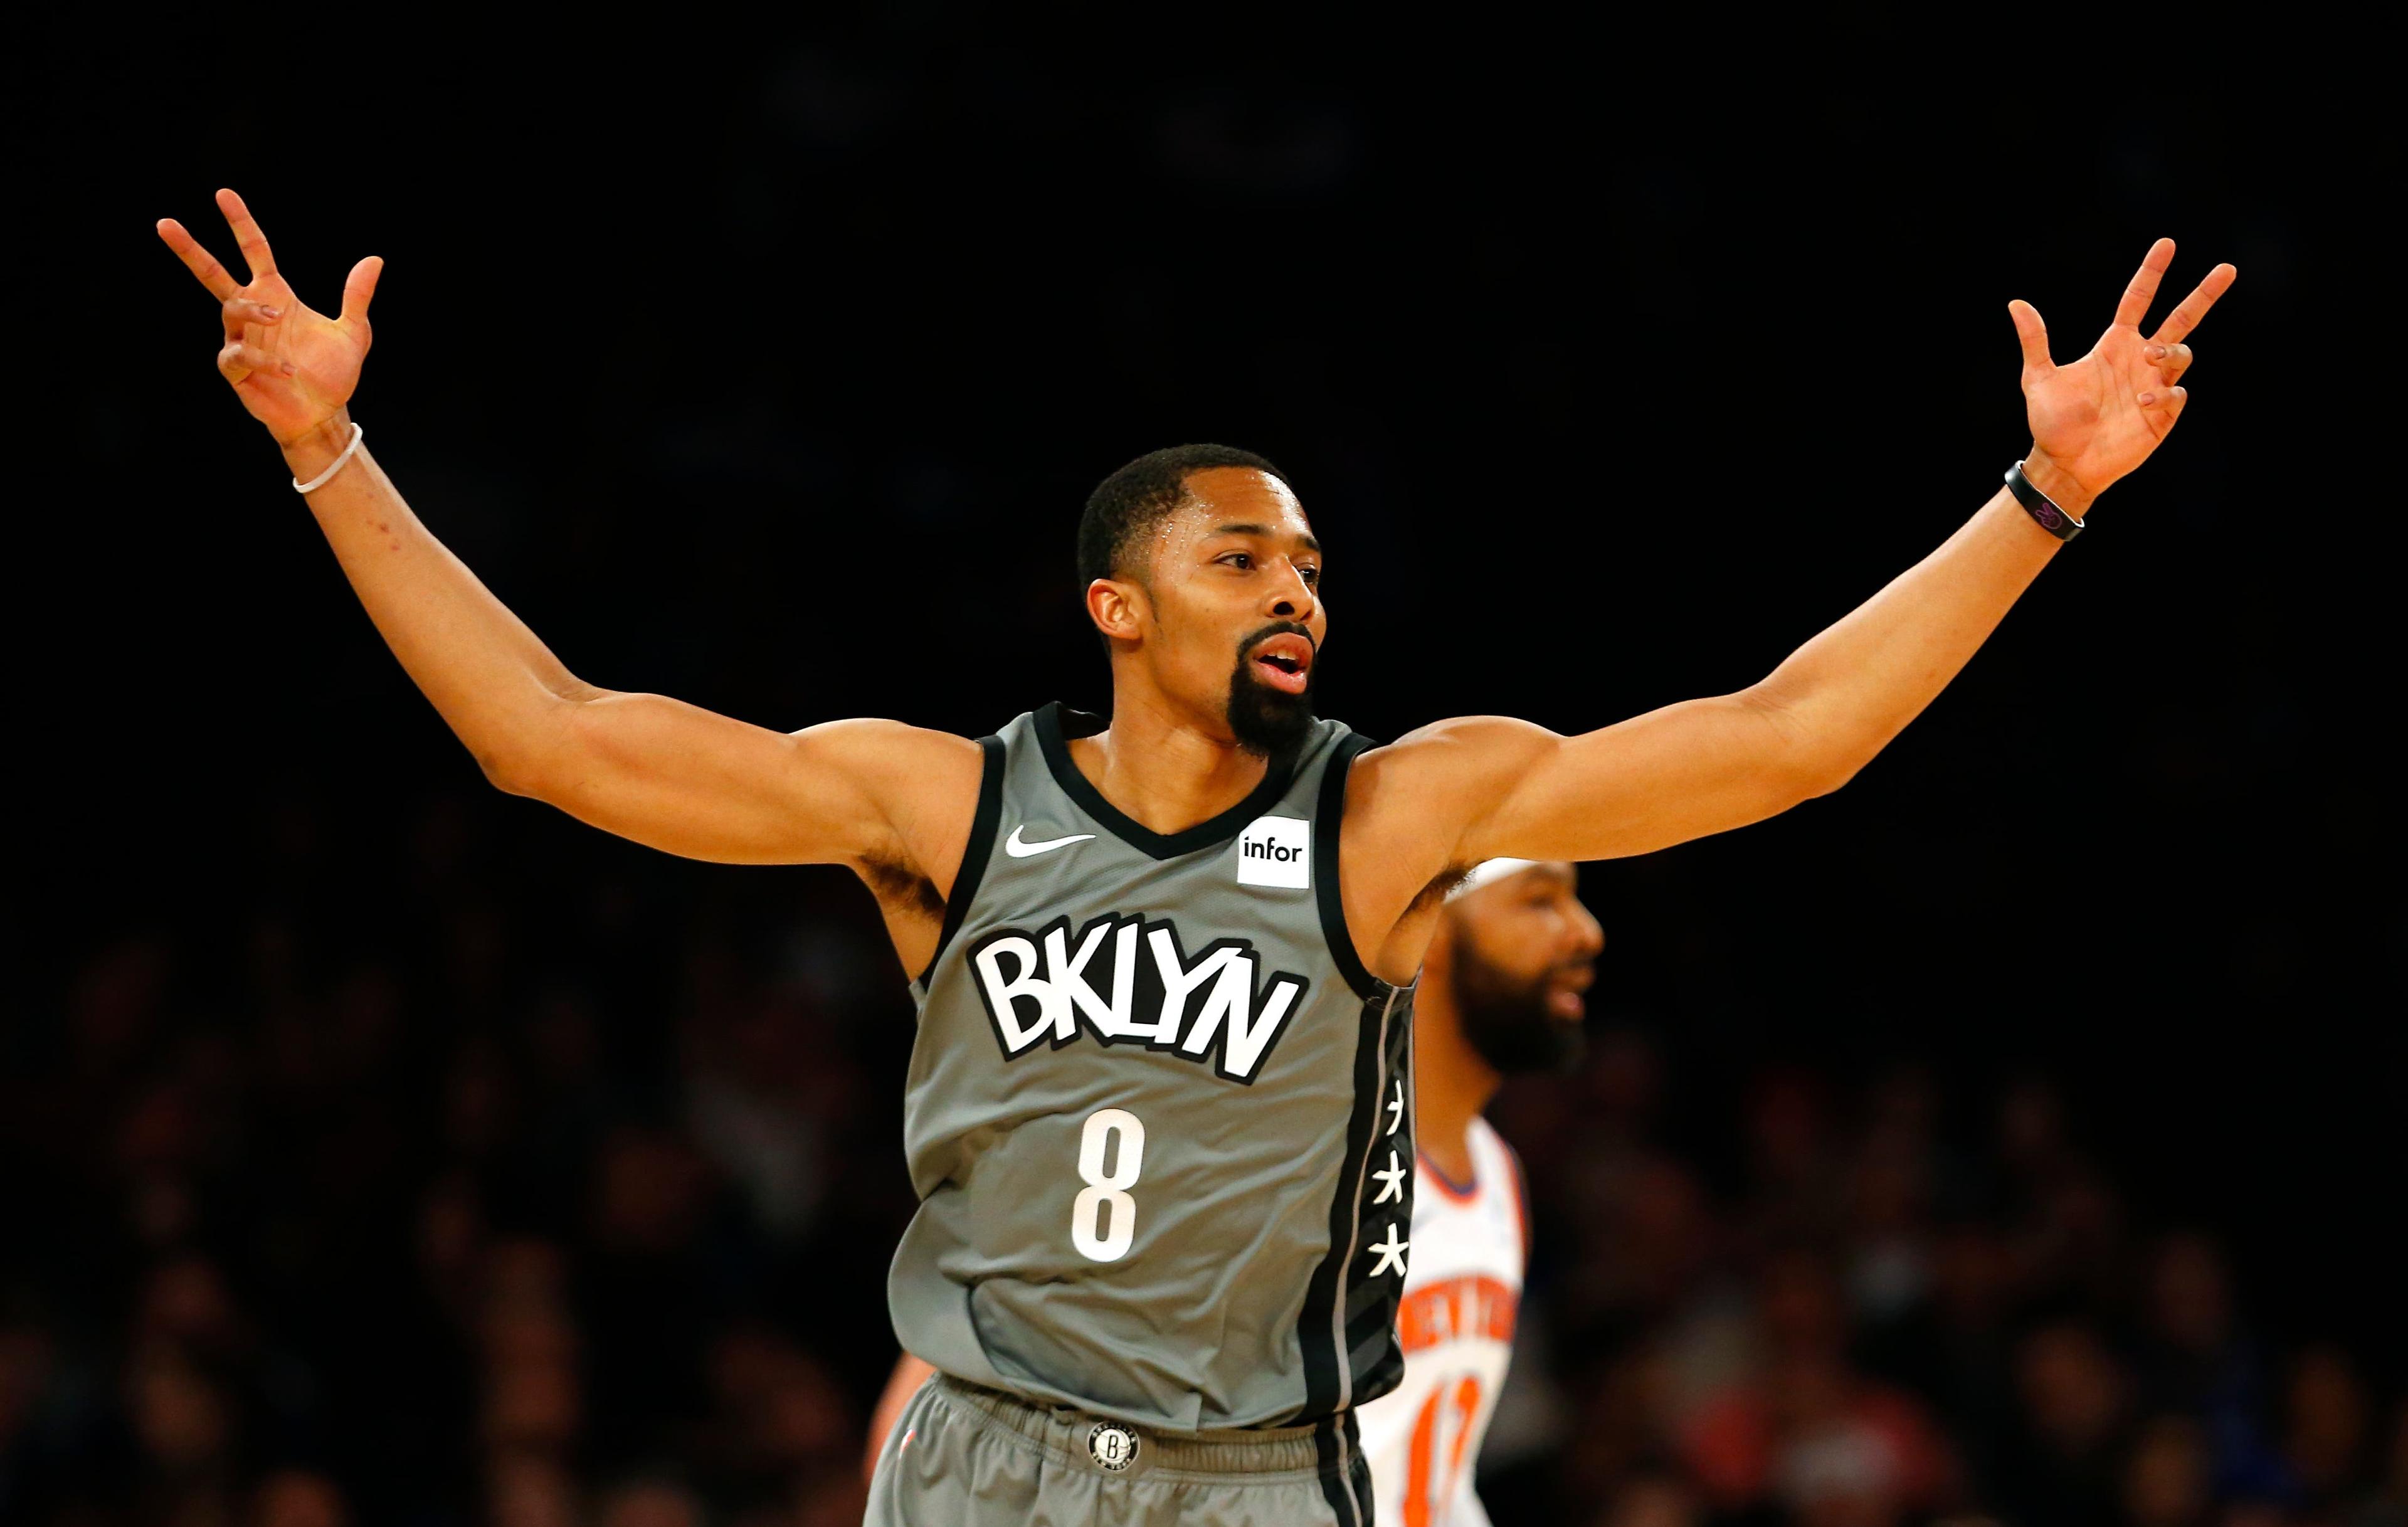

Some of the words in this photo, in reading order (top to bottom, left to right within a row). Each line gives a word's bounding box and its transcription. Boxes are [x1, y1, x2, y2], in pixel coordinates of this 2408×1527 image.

[1244, 835, 1303, 862] infor
[974, 921, 1301, 1078] BKLYN
[1071, 1107, 1146, 1263] 8
[1106, 1434, 1119, 1459] B
